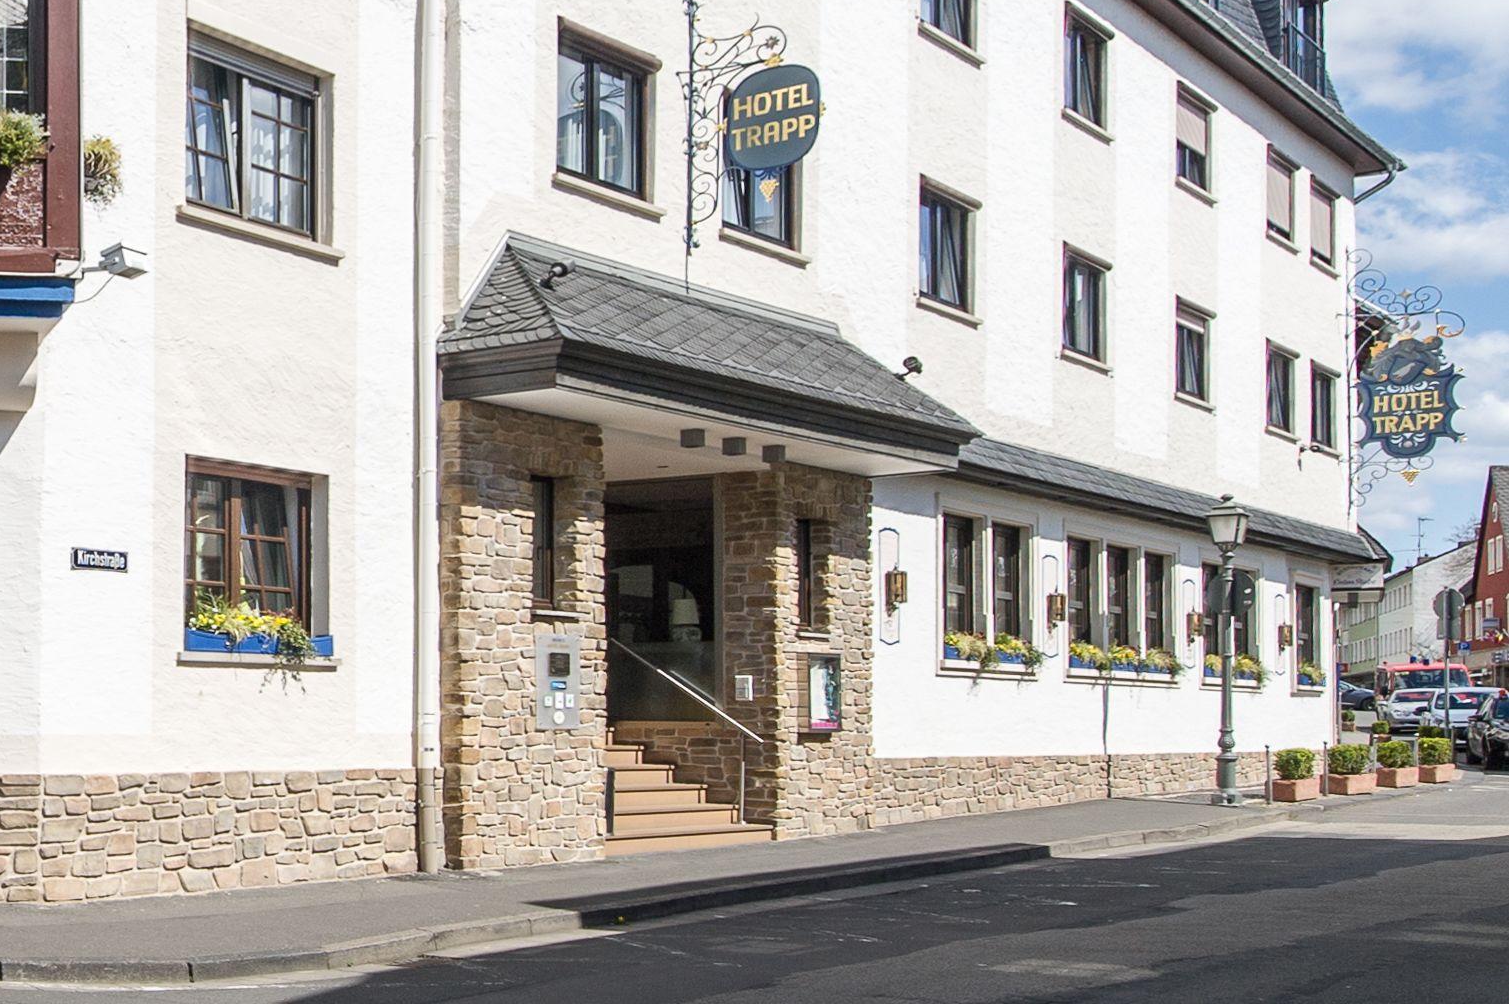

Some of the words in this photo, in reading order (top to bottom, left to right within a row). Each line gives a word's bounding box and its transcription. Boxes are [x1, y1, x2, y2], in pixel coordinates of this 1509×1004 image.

[733, 83, 814, 121] HOTEL
[731, 114, 816, 151] TRAPP
[1373, 390, 1445, 413] HOTEL
[1372, 412, 1444, 434] TRAPP
[77, 550, 125, 569] Kirchstraße
